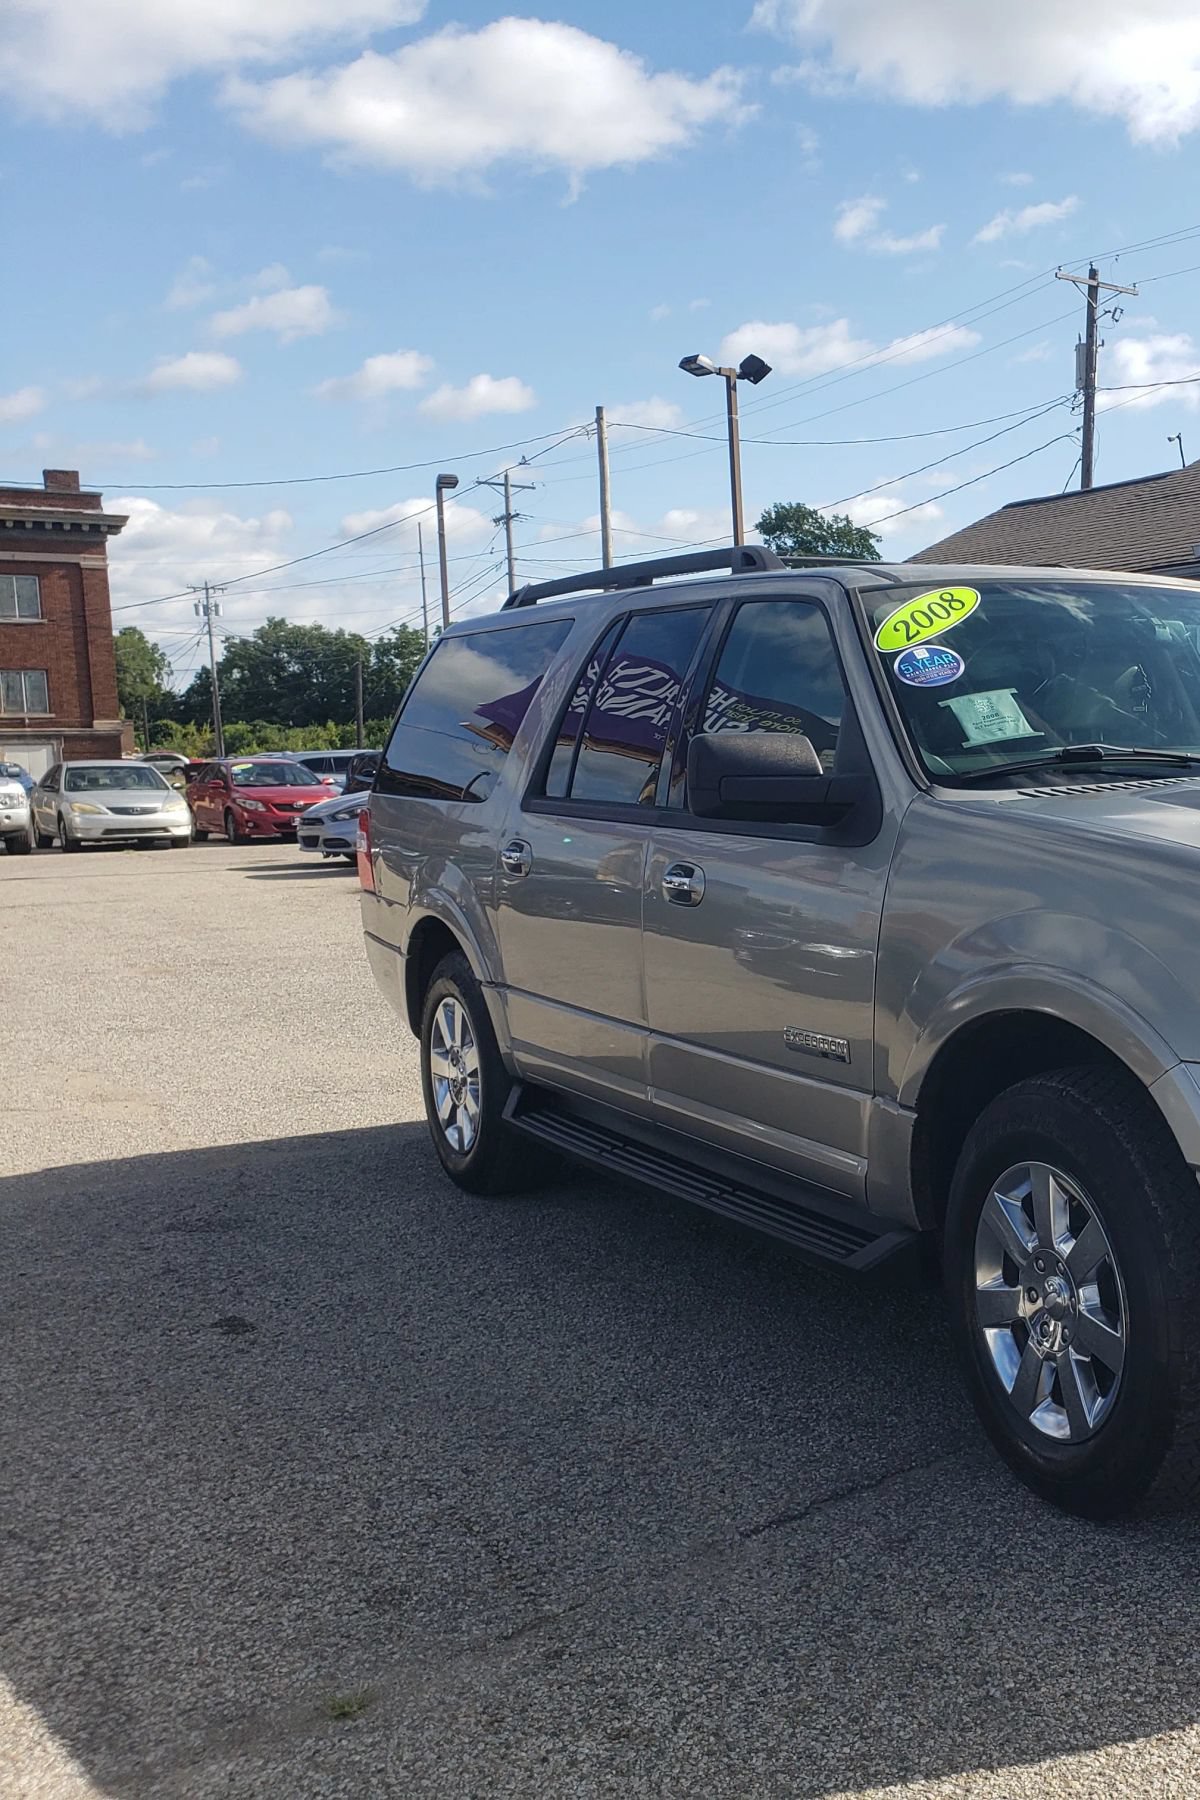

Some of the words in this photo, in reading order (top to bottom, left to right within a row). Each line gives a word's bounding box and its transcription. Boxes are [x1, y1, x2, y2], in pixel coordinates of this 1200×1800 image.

[893, 591, 966, 643] 2008
[900, 663, 914, 674] 5
[913, 653, 955, 670] YEAR
[784, 1029, 847, 1056] EXPEDITION
